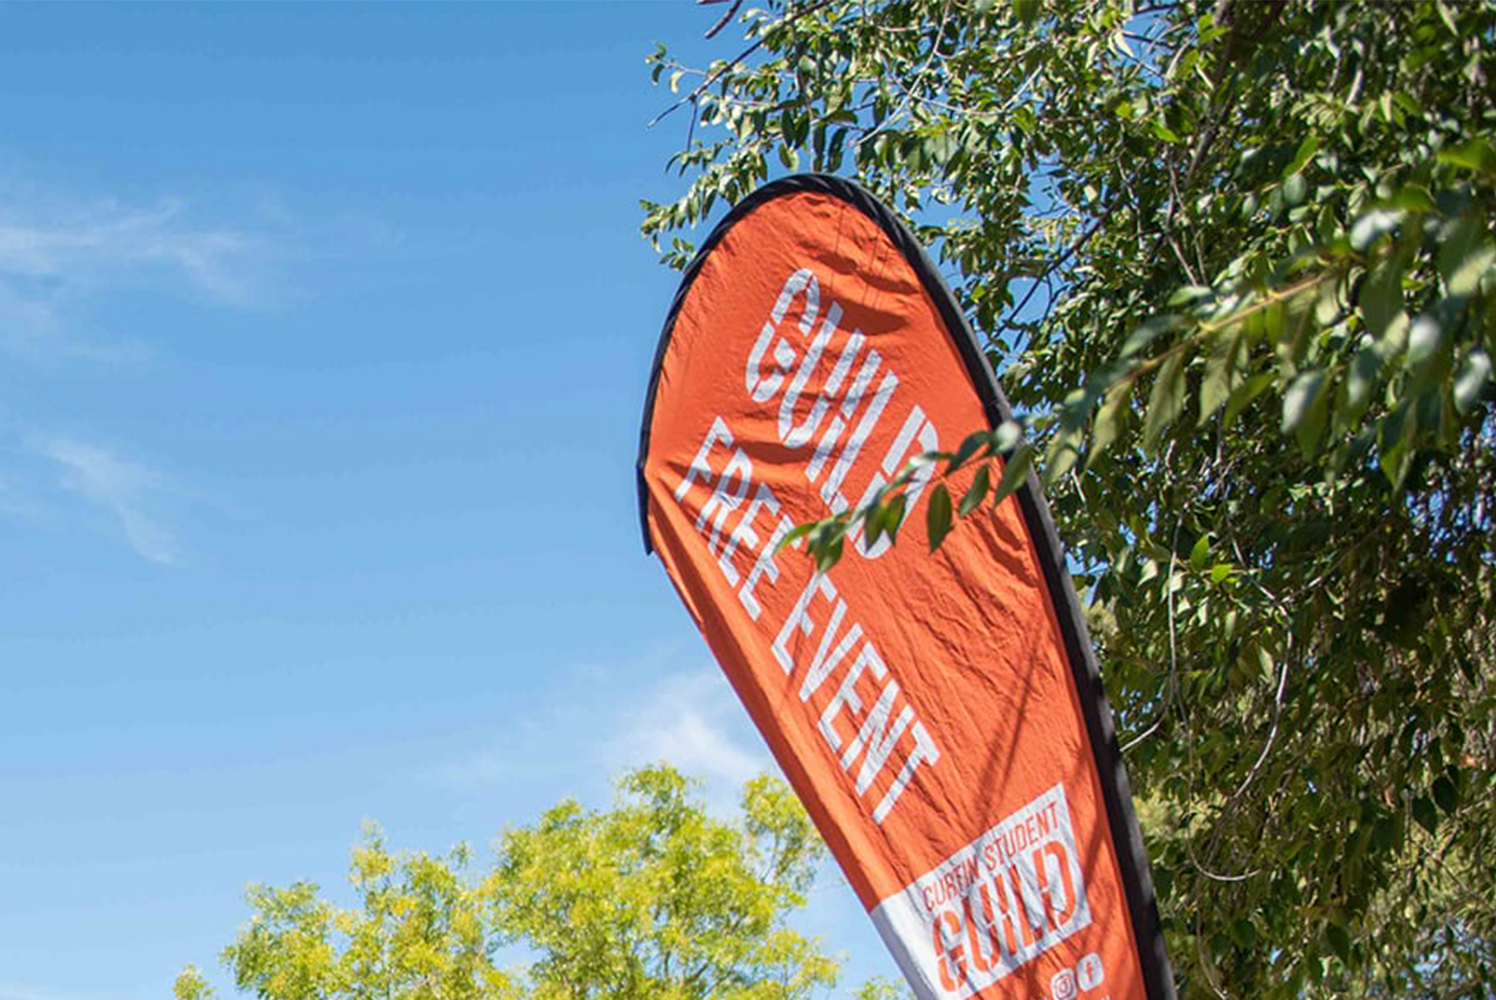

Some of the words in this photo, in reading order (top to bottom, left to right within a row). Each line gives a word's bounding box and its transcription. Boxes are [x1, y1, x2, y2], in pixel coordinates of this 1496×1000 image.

[746, 268, 939, 559] GUILD
[673, 415, 803, 622] FREE
[771, 570, 941, 825] EVENT
[921, 854, 980, 913] CURTIN
[984, 801, 1059, 872] STUDENT
[932, 840, 1077, 992] GUILD
